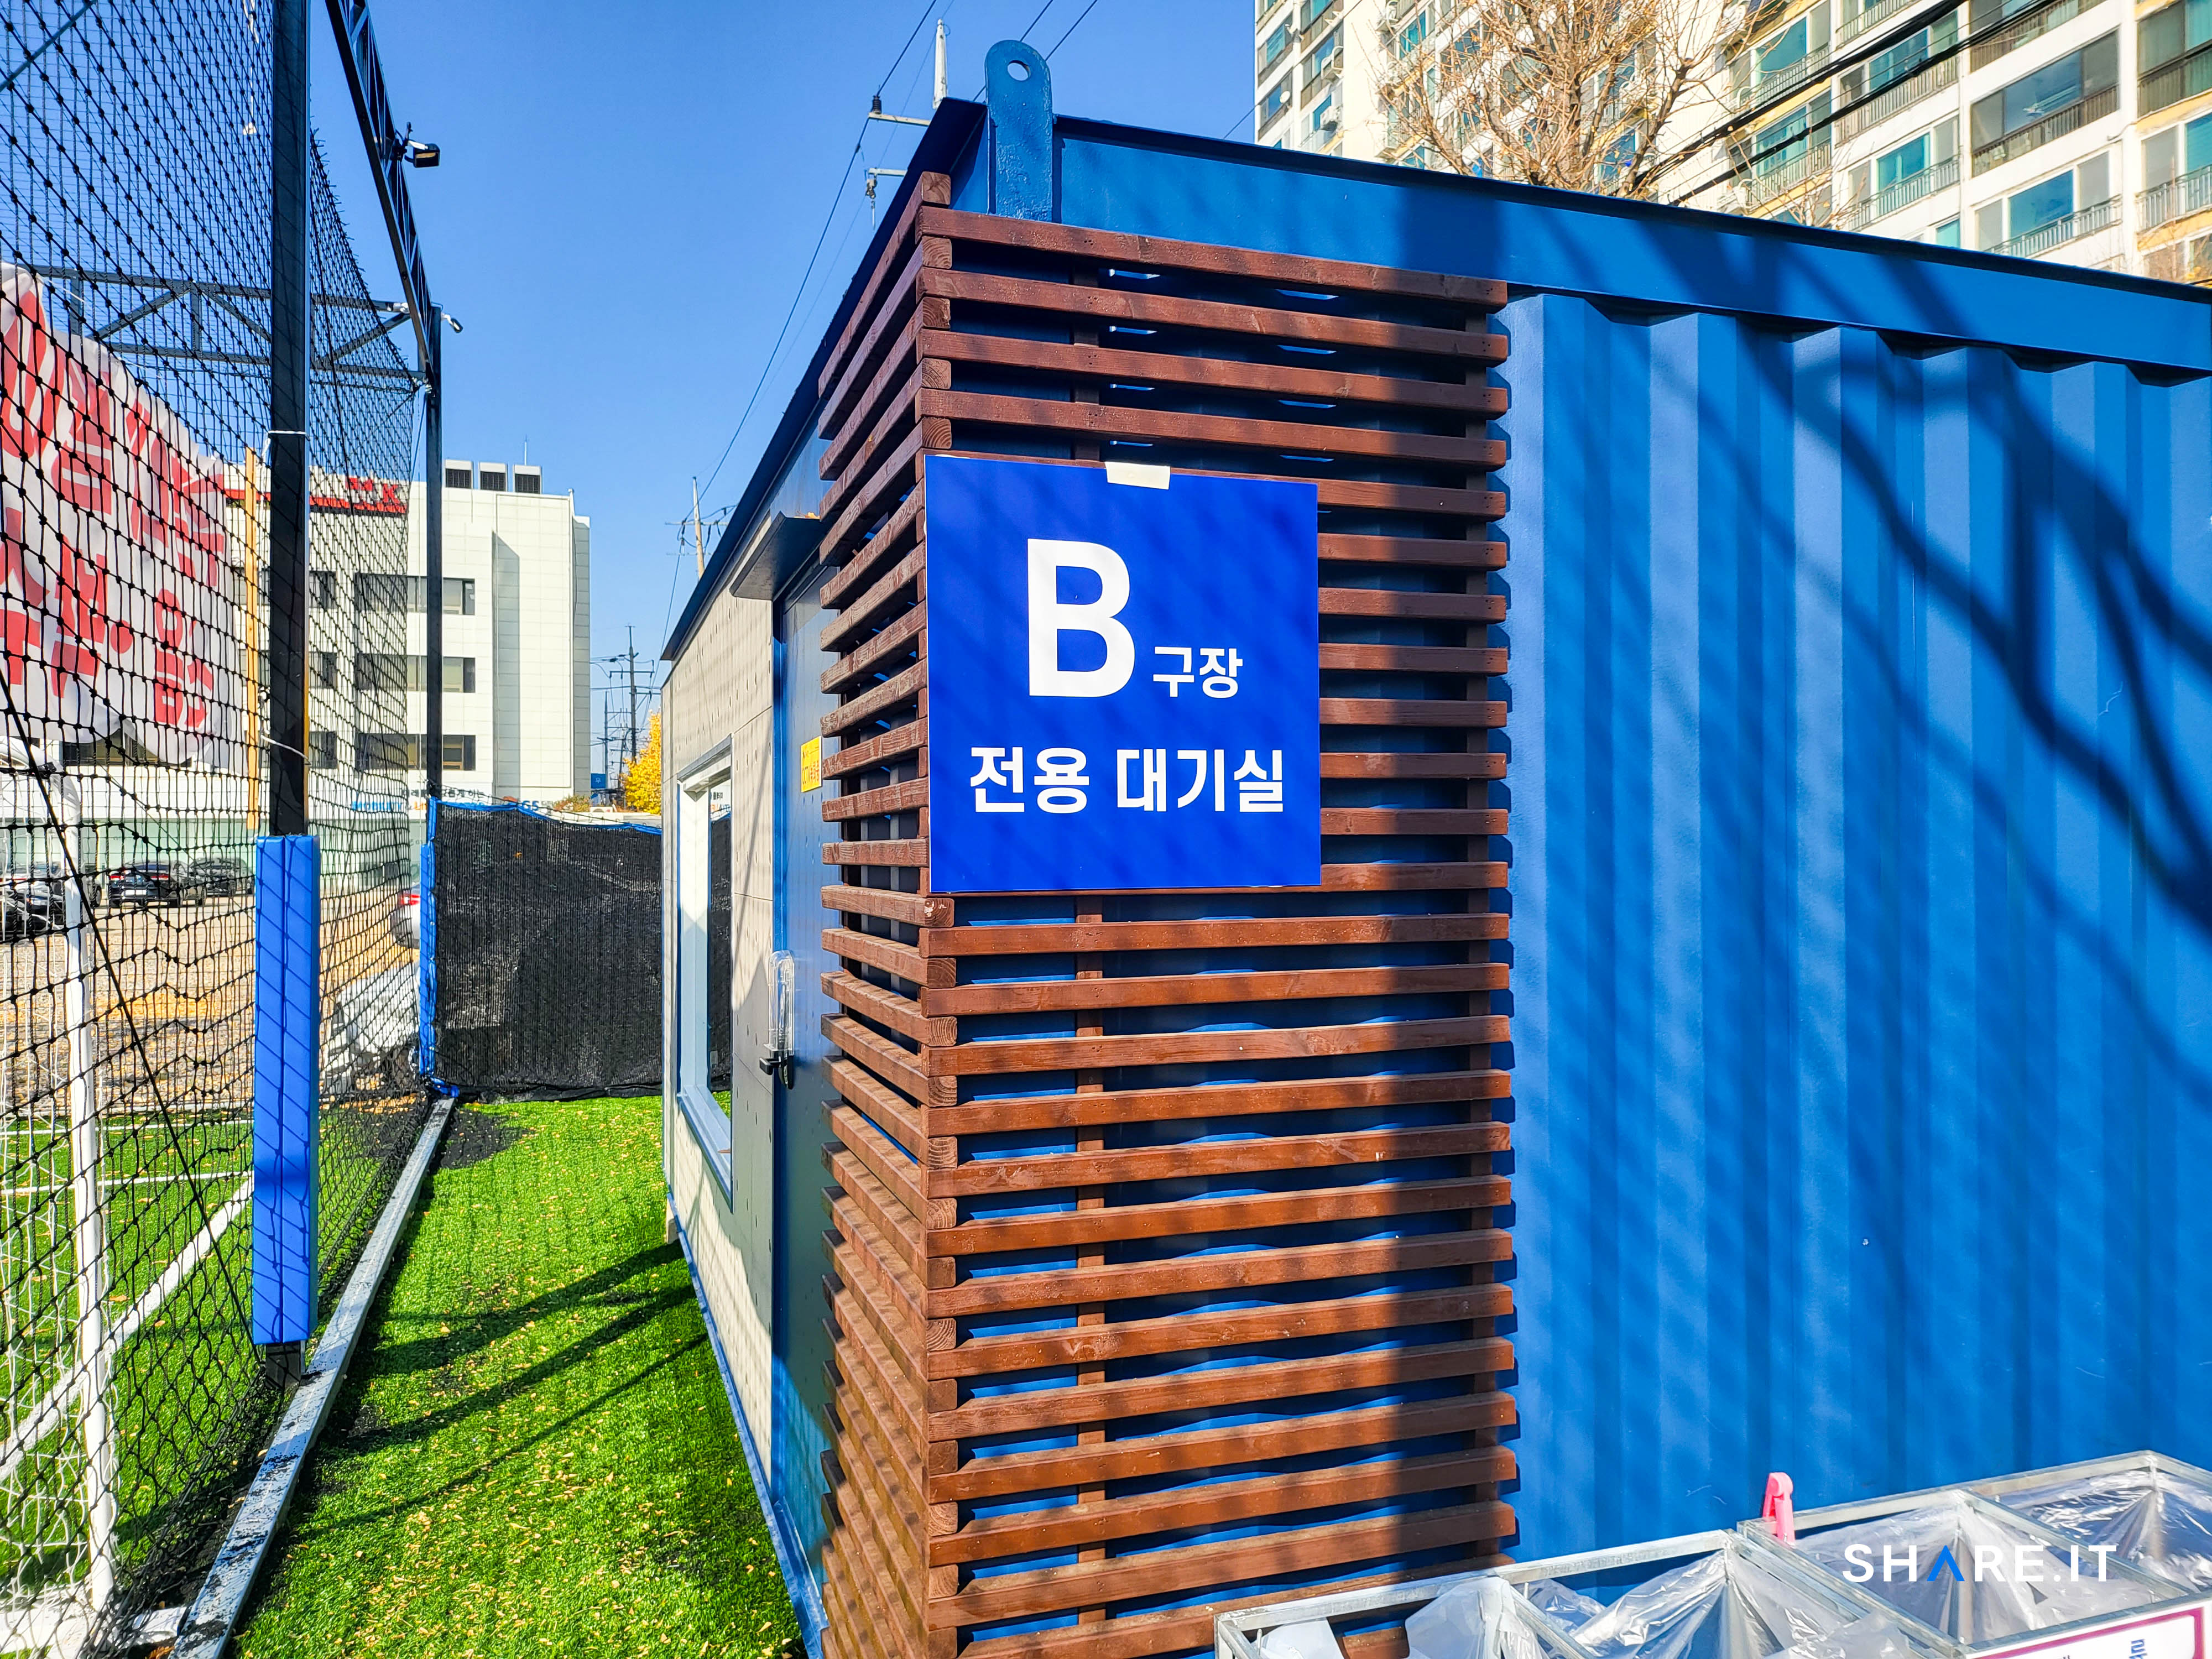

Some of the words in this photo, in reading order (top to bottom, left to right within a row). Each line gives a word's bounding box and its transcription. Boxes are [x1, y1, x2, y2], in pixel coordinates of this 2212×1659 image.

[1028, 539, 1135, 697] B
[1153, 646, 1243, 698] 구장
[970, 747, 1089, 813] 전용
[1117, 748, 1284, 812] 대기실
